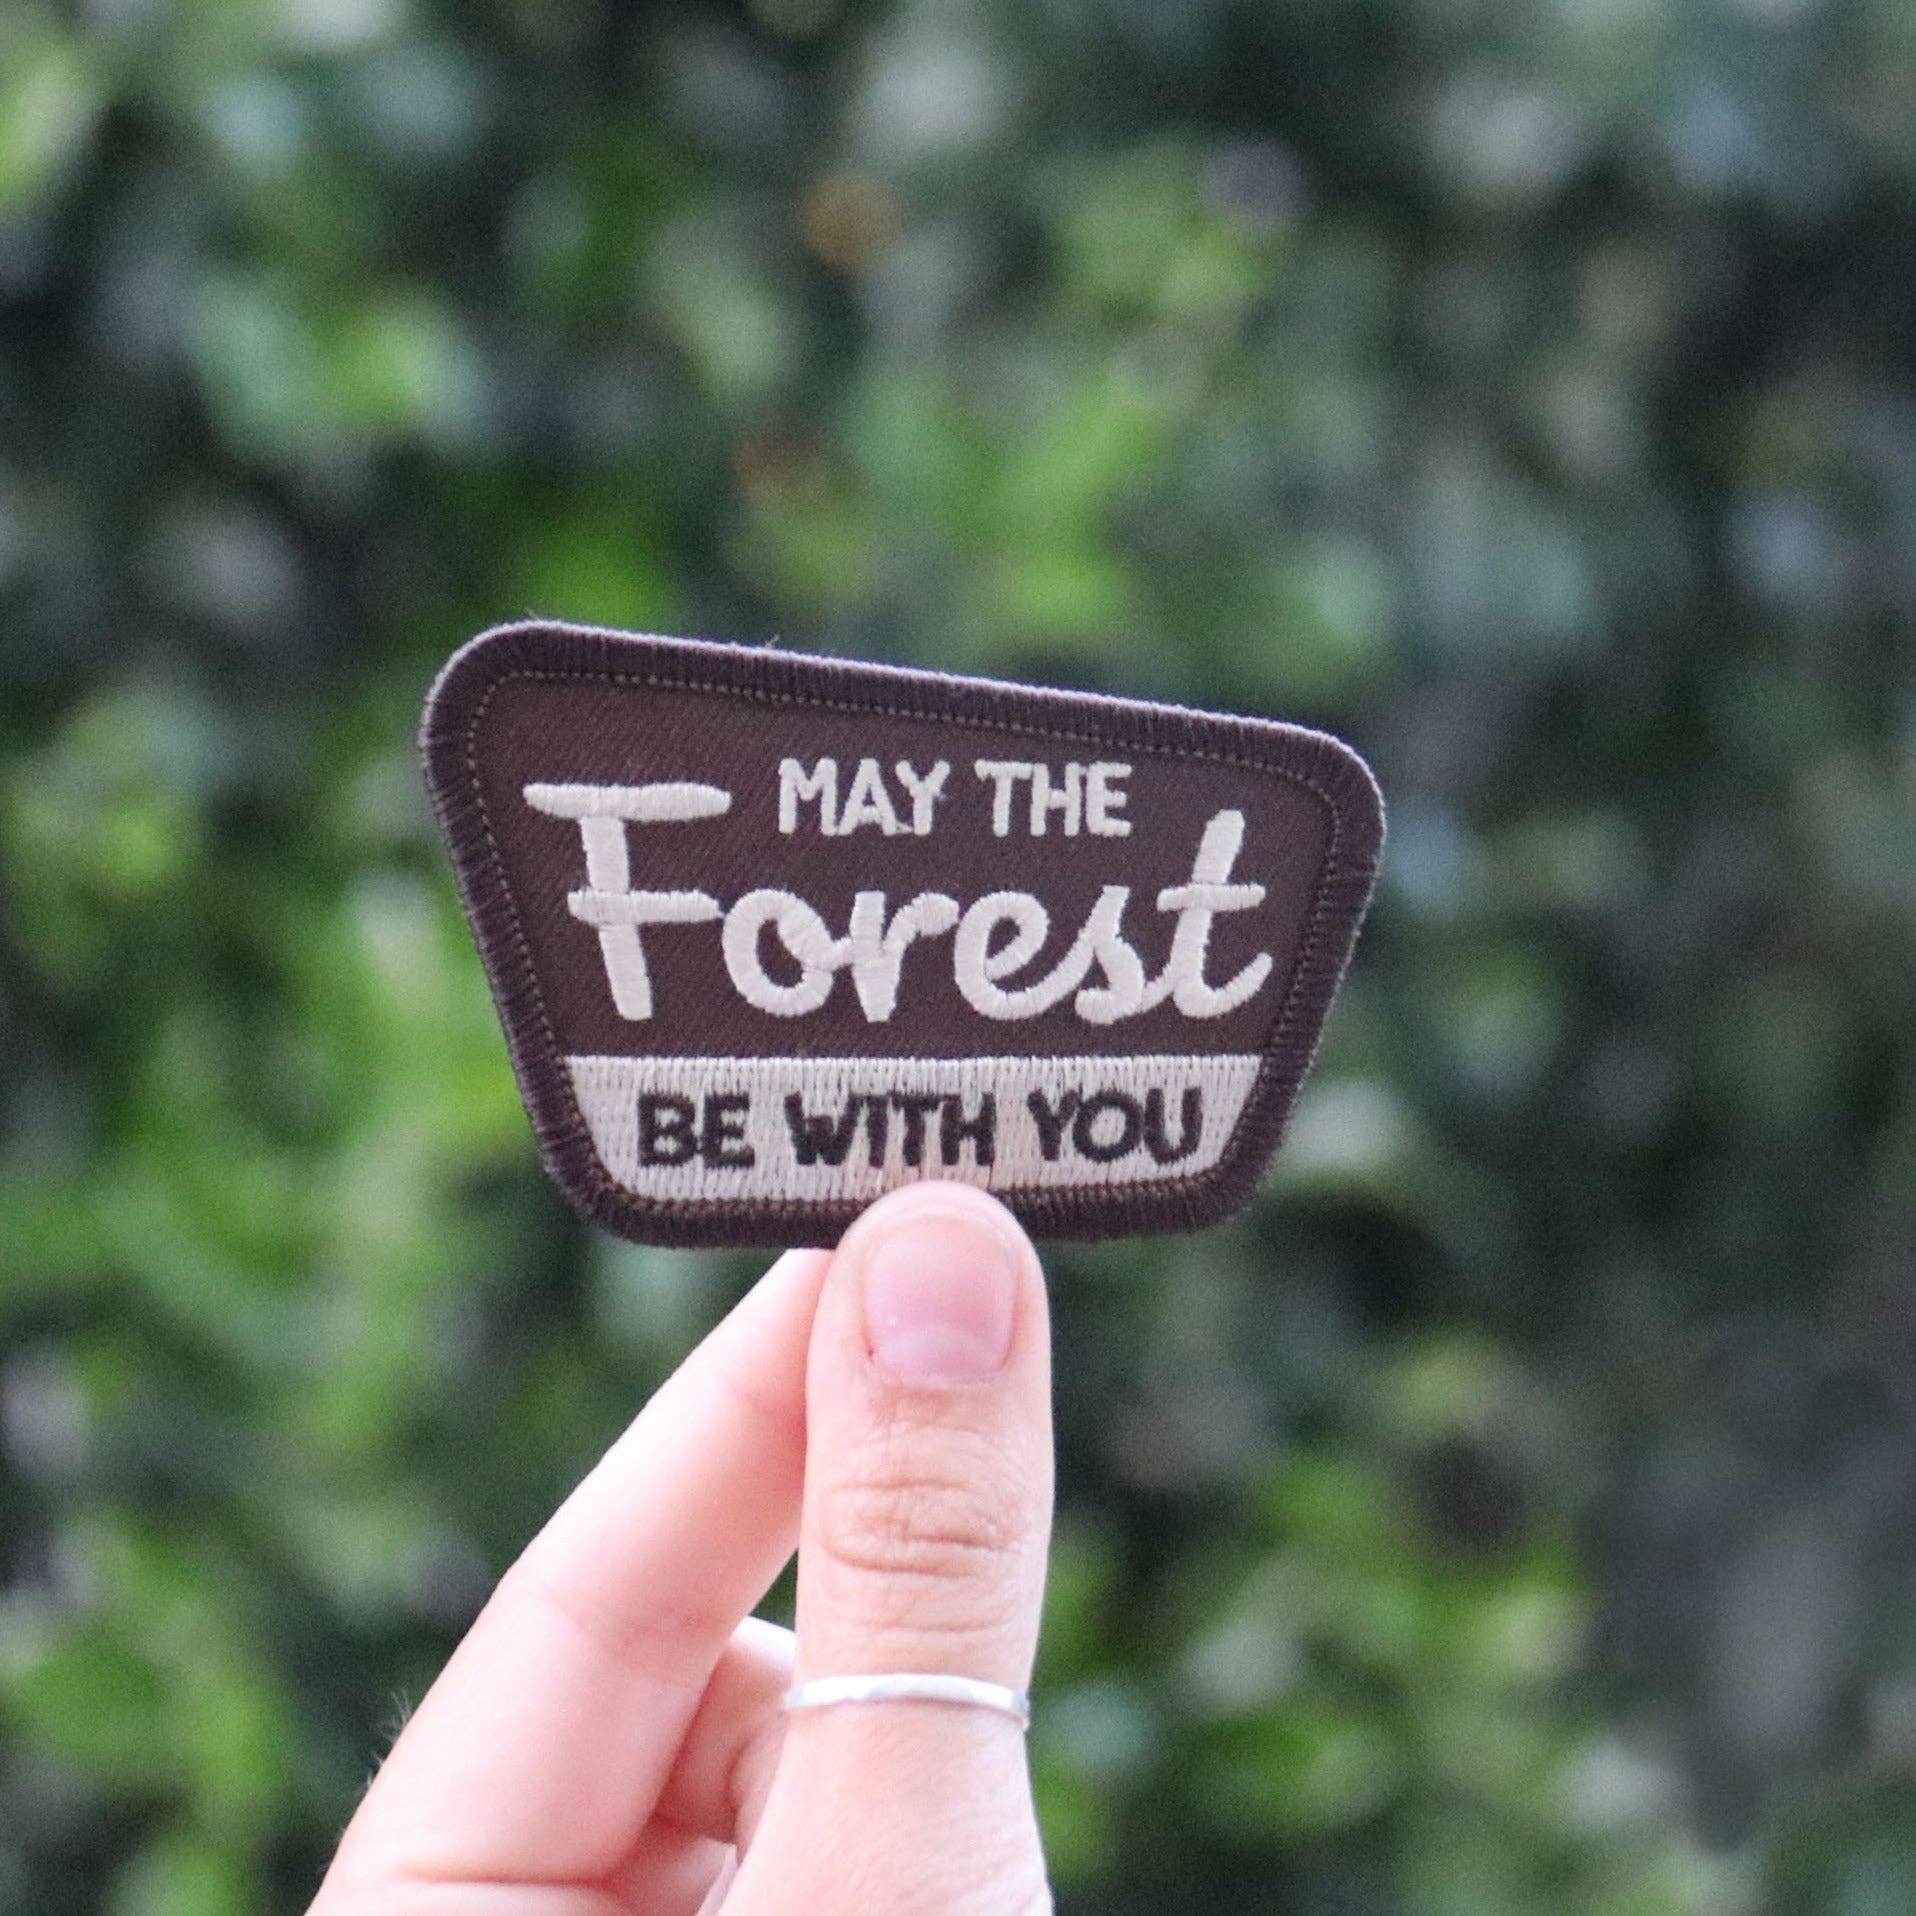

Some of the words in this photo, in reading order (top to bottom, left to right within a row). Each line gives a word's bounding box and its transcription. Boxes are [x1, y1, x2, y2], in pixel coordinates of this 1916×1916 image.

[778, 758, 951, 837] MAY
[974, 758, 1133, 838] THE
[523, 782, 1273, 1024] Forest
[638, 1092, 756, 1168] BE
[785, 1090, 998, 1168] WITH
[1027, 1086, 1204, 1166] YOU
